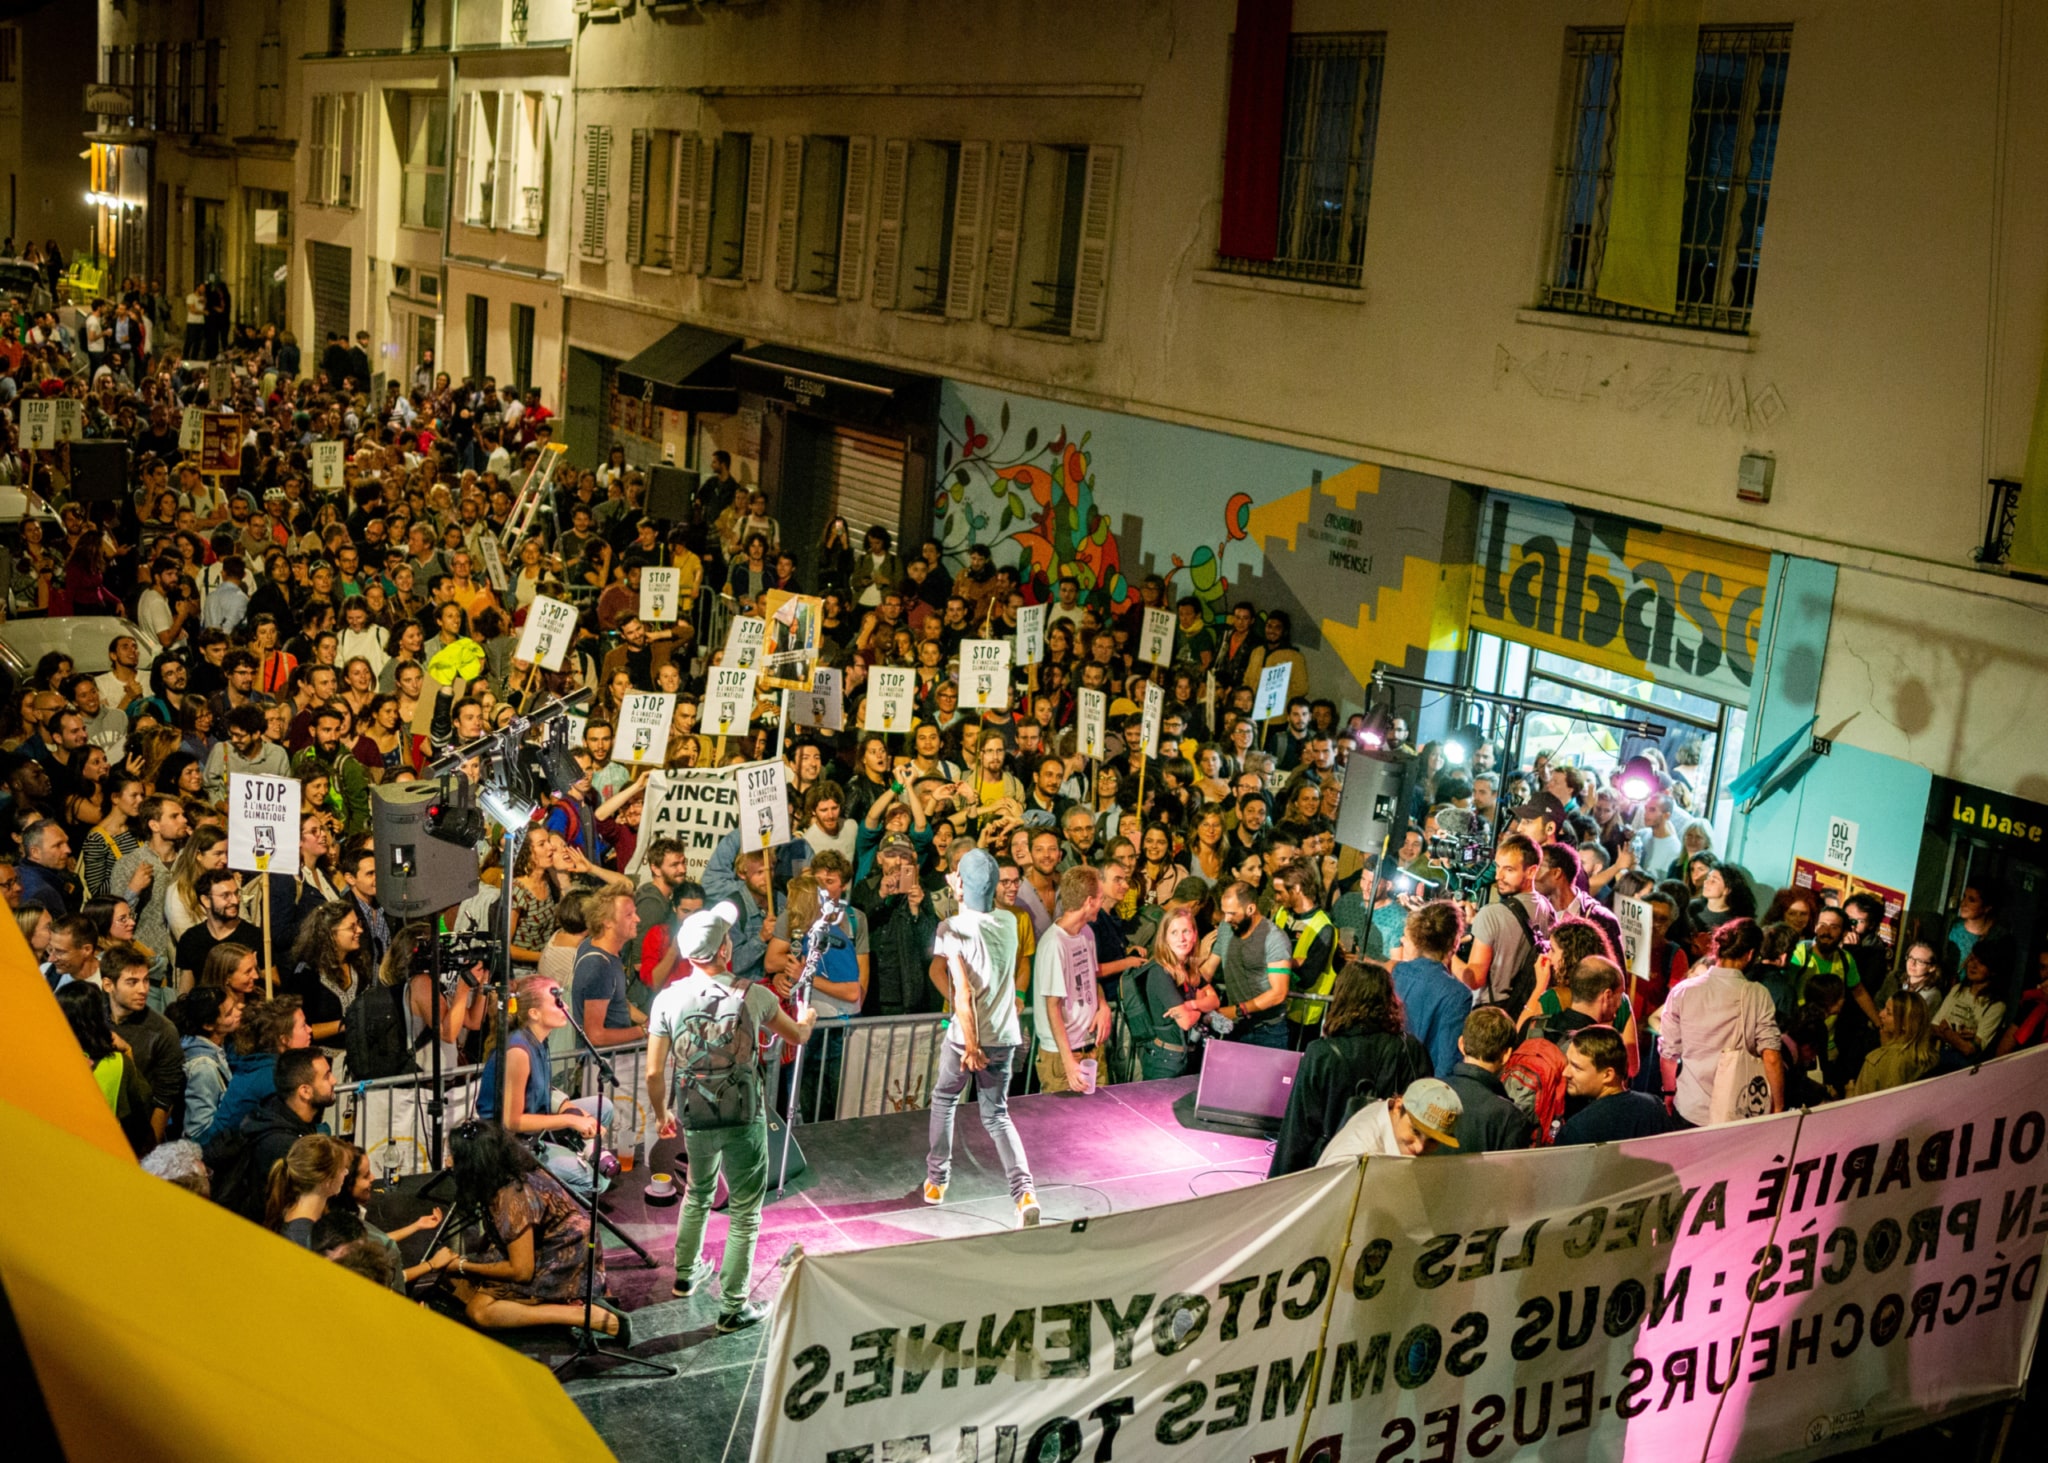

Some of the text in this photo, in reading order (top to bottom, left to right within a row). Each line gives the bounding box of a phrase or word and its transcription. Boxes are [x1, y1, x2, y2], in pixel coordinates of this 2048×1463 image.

[28, 402, 49, 413] STOP
[320, 446, 337, 456] STOP
[650, 572, 671, 583] STOP
[541, 602, 568, 621] STOP
[1024, 608, 1039, 622] STOP
[1151, 611, 1170, 626] STOP
[741, 620, 766, 635] STO
[973, 645, 1000, 660] STOP
[718, 670, 747, 686] STOP
[880, 673, 905, 686] STOP
[1267, 666, 1286, 681] STOP
[633, 695, 665, 711] STOP
[1084, 691, 1101, 708] STOP
[748, 767, 776, 790] STOP
[245, 779, 287, 803] STOP
[250, 801, 287, 813] L'INACTION
[244, 809, 286, 822] CLIMATIQUE
[1952, 795, 2043, 843] la base
[1832, 822, 1849, 842] OÙ
[1831, 838, 1845, 850] EST
[1621, 899, 1643, 921] STOP
